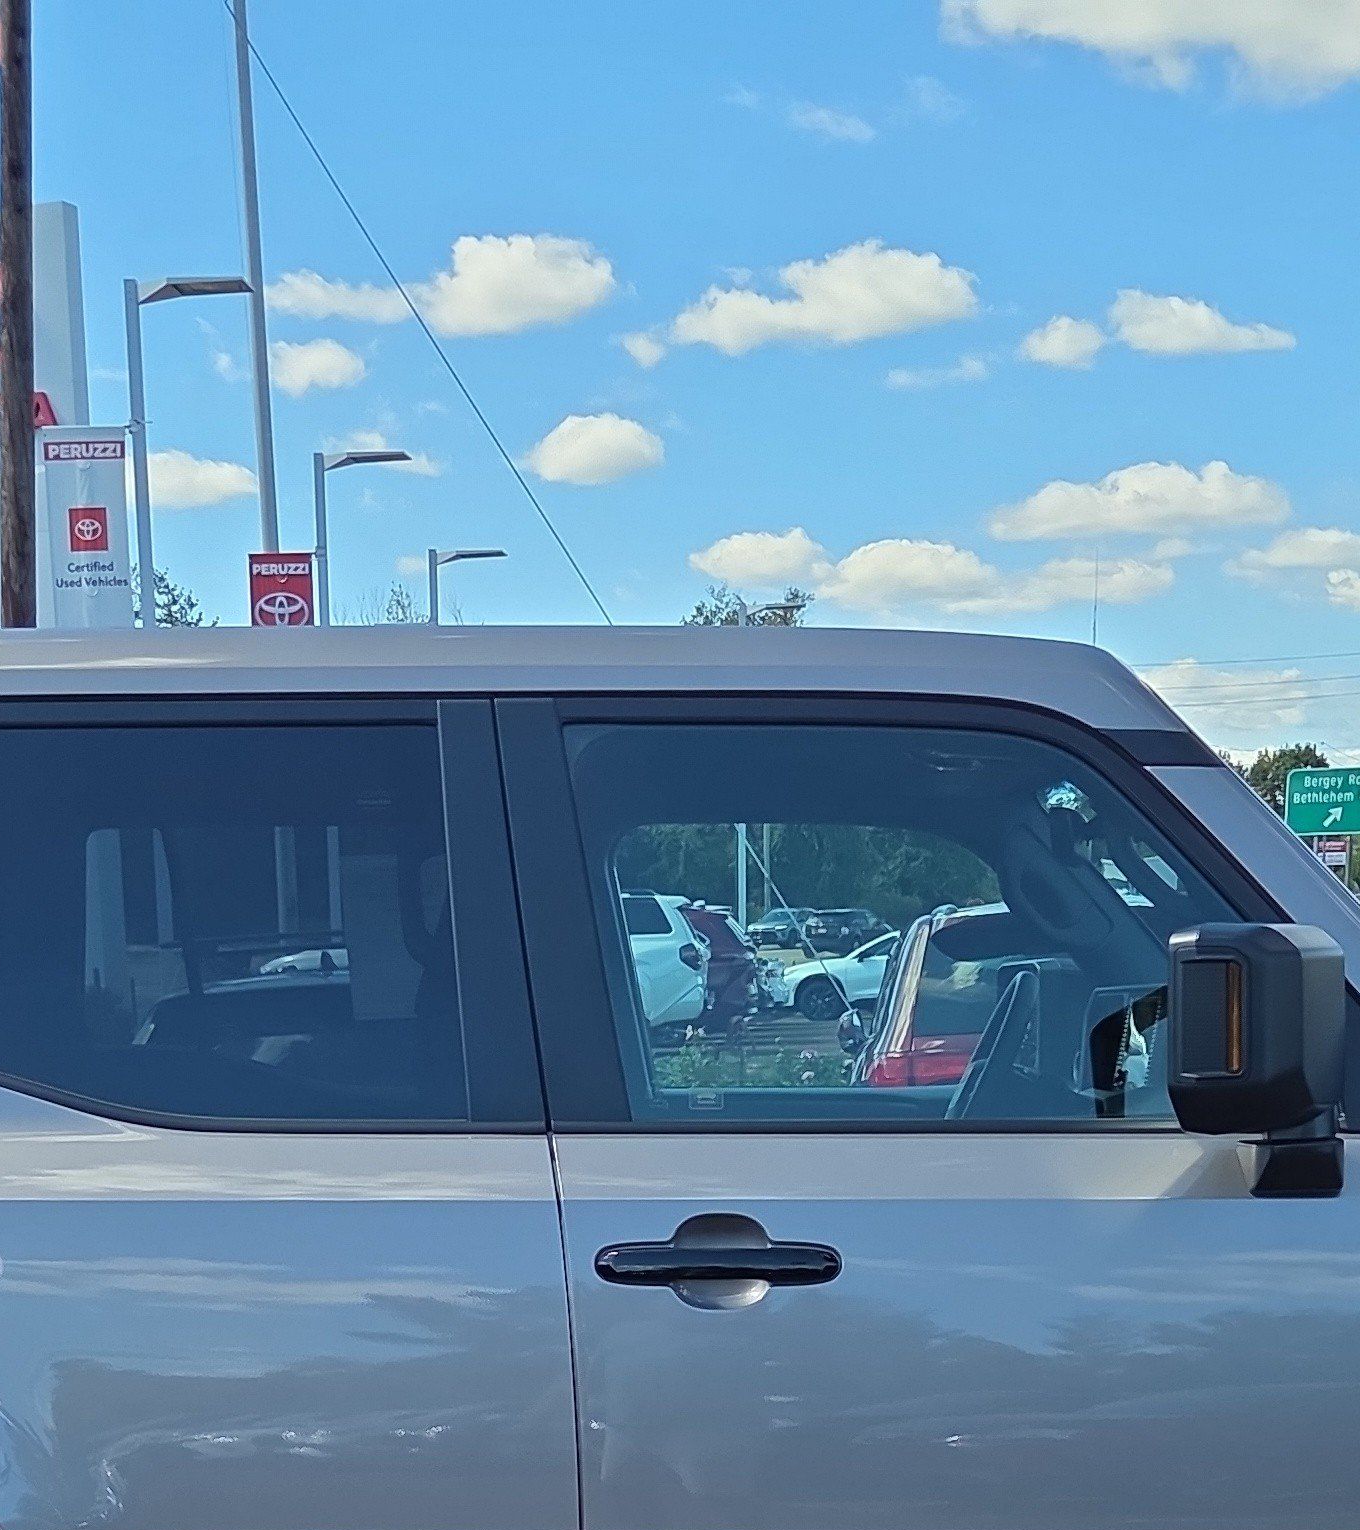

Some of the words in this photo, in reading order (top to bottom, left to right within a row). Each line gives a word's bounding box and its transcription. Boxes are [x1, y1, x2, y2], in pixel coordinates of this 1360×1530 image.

[48, 443, 121, 458] PERUZZI
[67, 561, 114, 573] Certified
[252, 563, 309, 575] PERUZZI
[56, 578, 82, 589] Used
[84, 576, 129, 588] Vehicles
[1303, 775, 1343, 789] Bergey
[1293, 790, 1355, 804] Bethlehem
